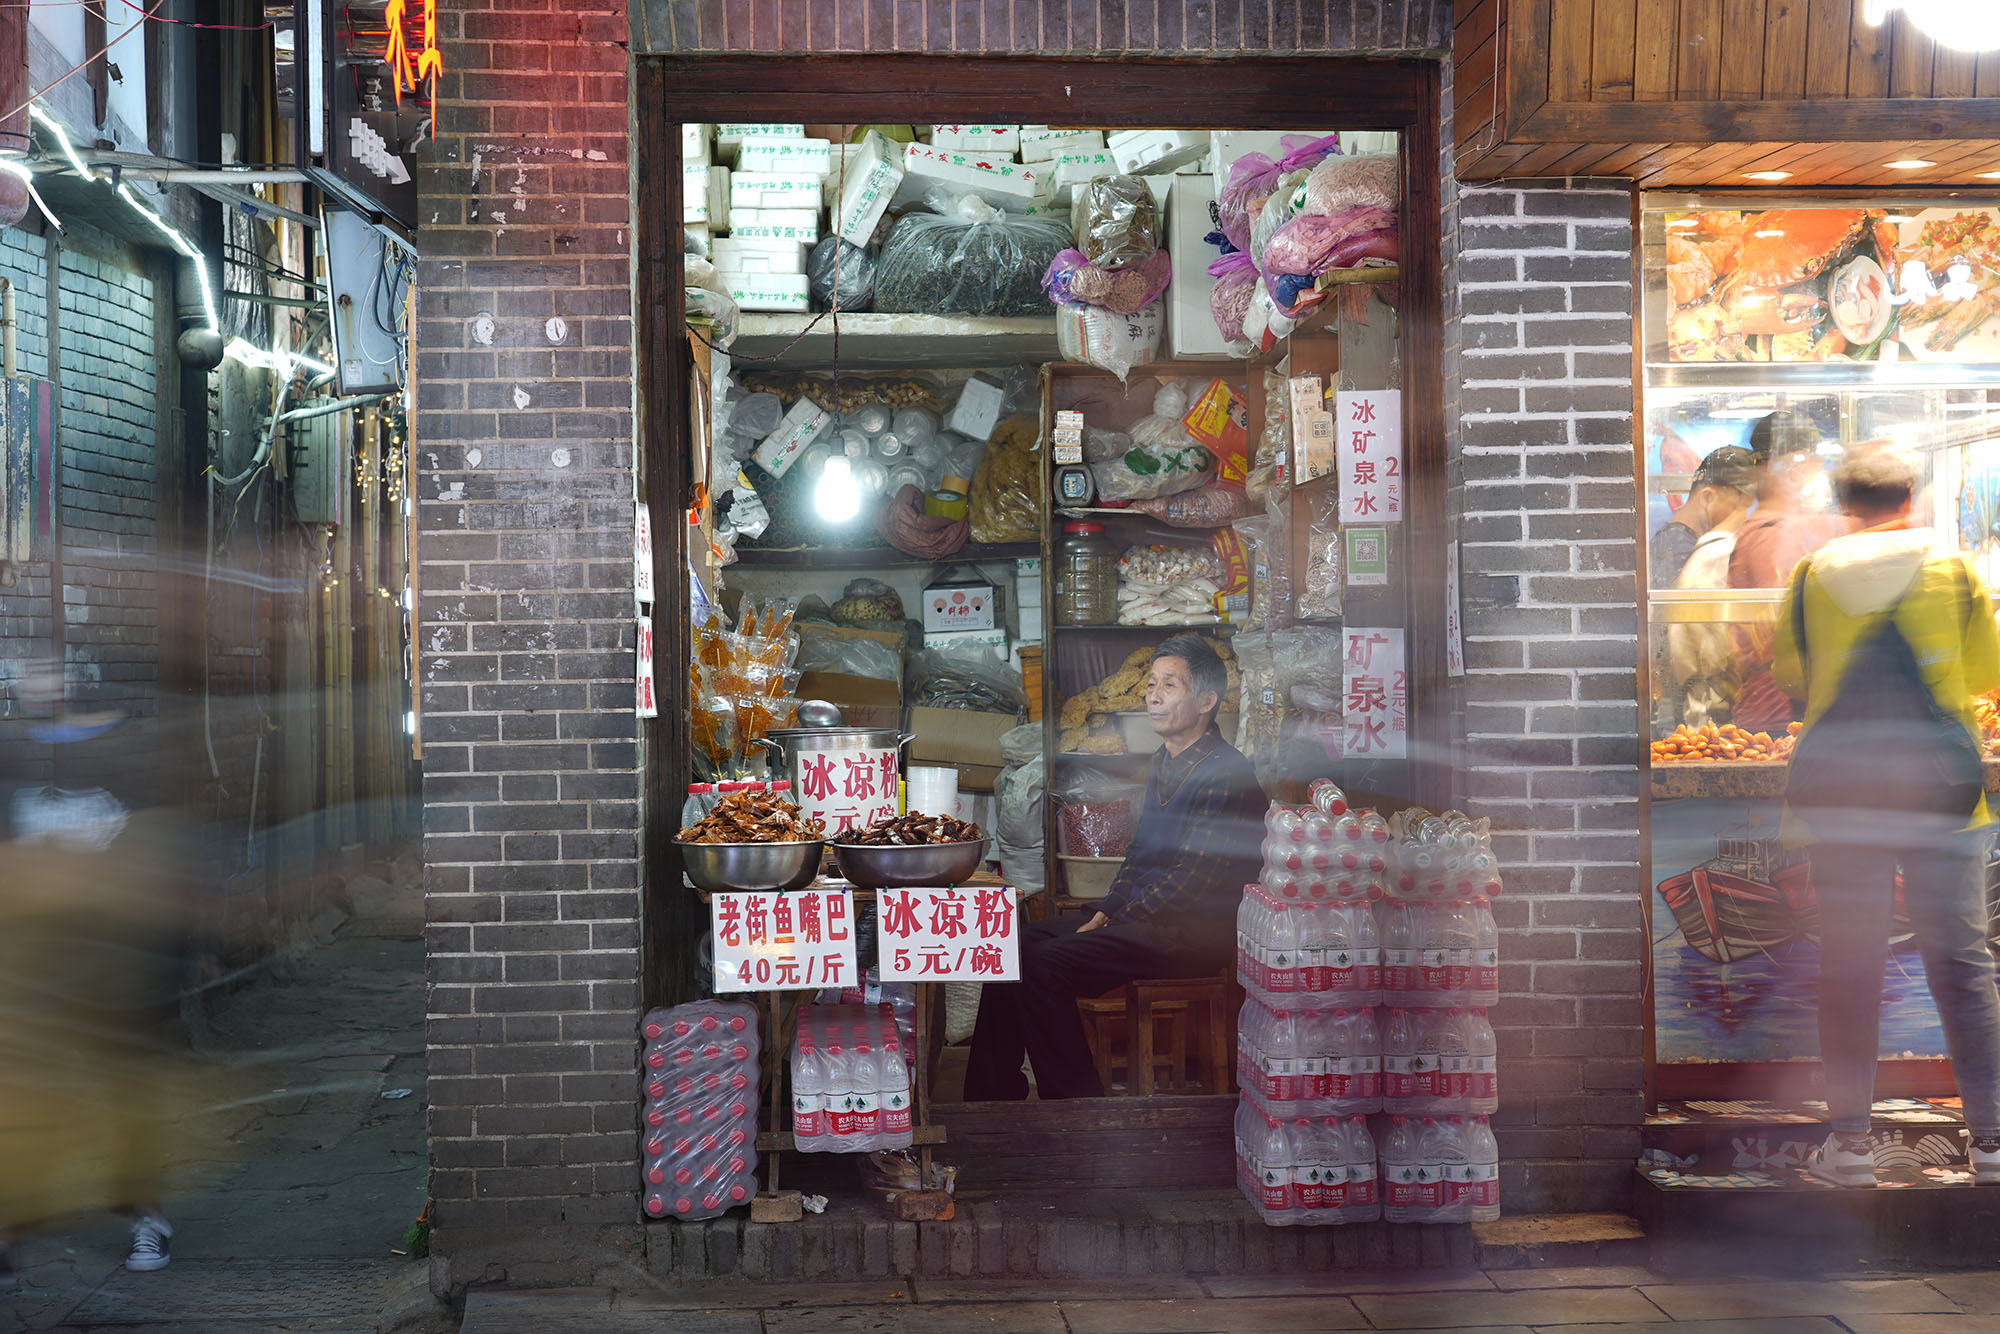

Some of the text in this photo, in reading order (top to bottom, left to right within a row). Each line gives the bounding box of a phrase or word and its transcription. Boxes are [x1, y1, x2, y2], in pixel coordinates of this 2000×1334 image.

[1351, 399, 1378, 516] 冰矿泉水
[1385, 456, 1400, 513] 2元/瓶
[1346, 633, 1388, 753] 矿泉水
[1391, 670, 1405, 732] 2元/瓶
[801, 752, 897, 801] 冰凉粉
[718, 892, 849, 947] 老街鱼嘴巴
[882, 889, 1015, 939] 冰凉粉
[737, 953, 845, 986] 40元/斤
[894, 943, 1005, 976] 5元/碗
